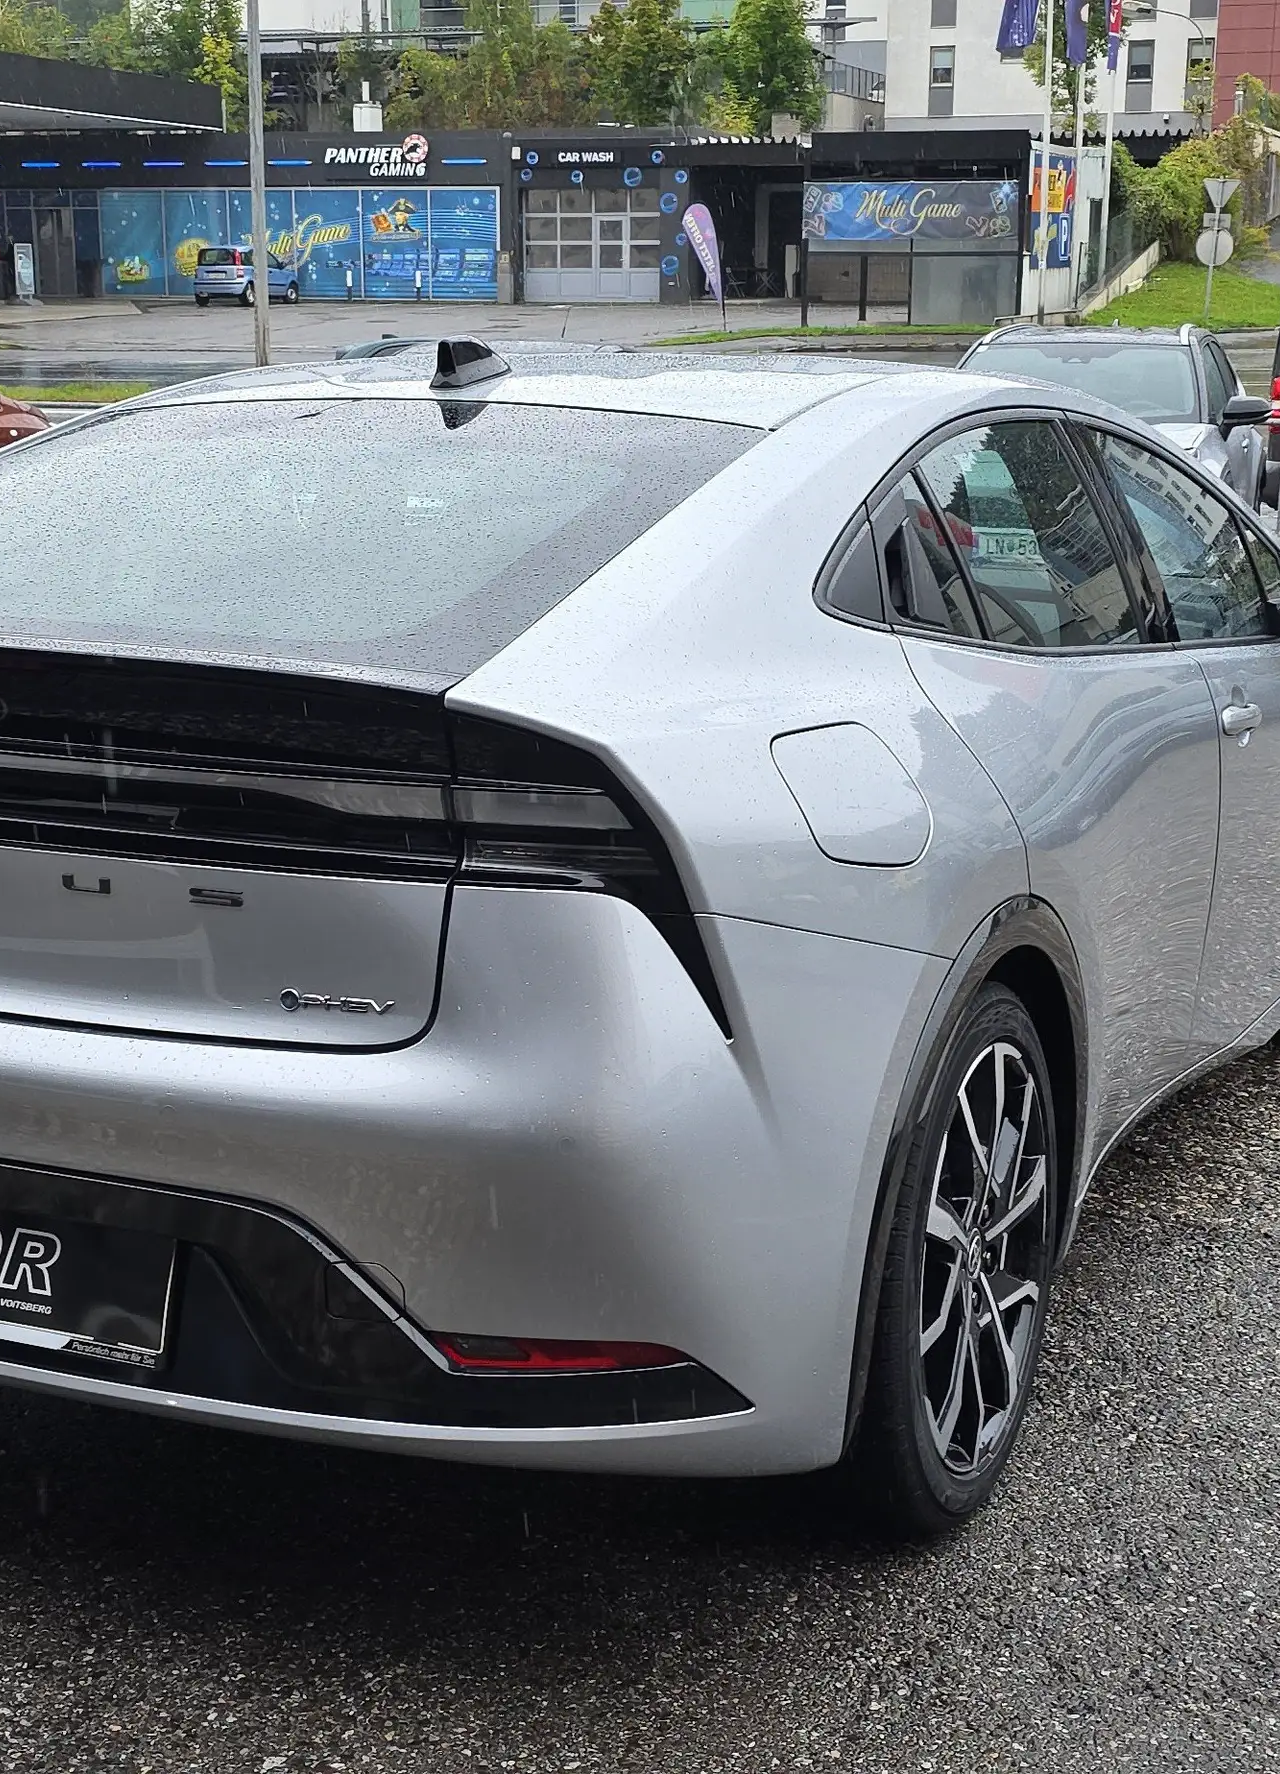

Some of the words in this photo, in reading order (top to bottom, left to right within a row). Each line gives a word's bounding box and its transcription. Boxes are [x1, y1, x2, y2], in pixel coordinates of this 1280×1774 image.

[324, 147, 403, 163] PANTHER
[558, 151, 580, 163] CAR
[581, 151, 614, 163] WASH
[369, 162, 427, 177] GAMING
[855, 189, 908, 229] Multi
[906, 188, 962, 235] Game
[0, 1298, 53, 1316] VOITSBERG
[110, 1350, 129, 1360] mehr
